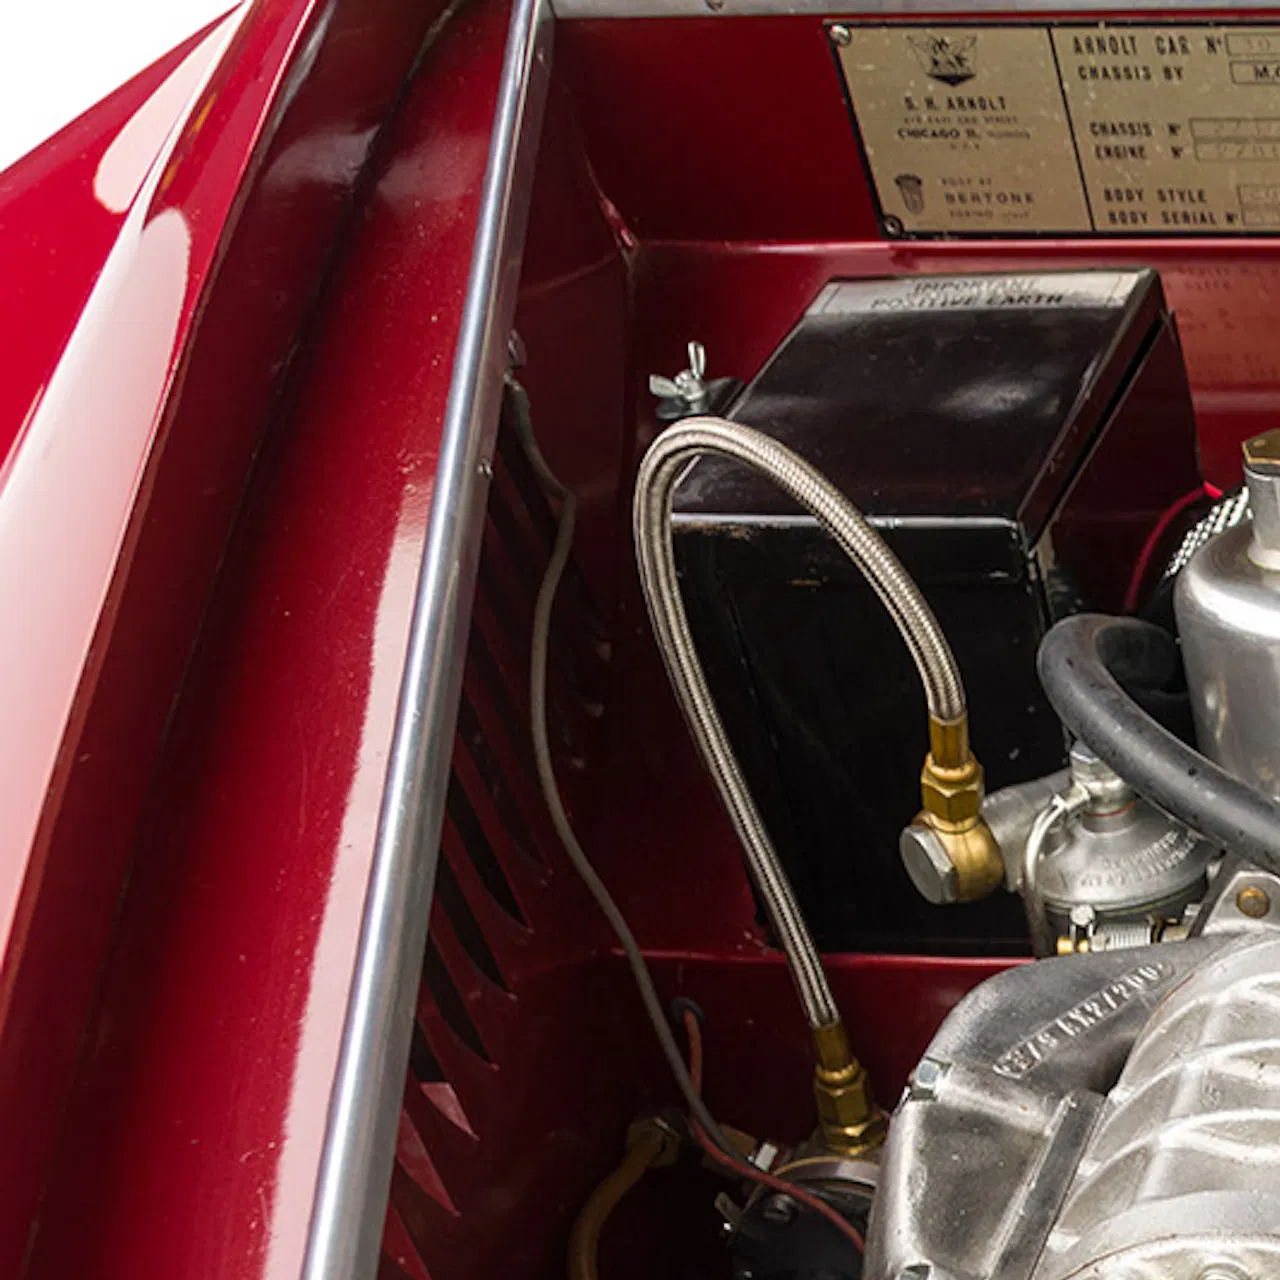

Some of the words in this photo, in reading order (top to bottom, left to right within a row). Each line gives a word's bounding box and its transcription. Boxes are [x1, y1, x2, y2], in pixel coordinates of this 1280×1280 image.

[1073, 36, 1138, 55] ARNOLT
[1156, 36, 1190, 55] CAR
[1078, 66, 1151, 81] CHASSIS
[1164, 66, 1184, 80] BY
[946, 96, 1007, 111] ARNOLT
[897, 127, 960, 140] CHICAGO
[1089, 122, 1153, 137] CHASSIS
[1095, 146, 1148, 160] ENGINE
[945, 191, 1035, 205] BERTONE
[1104, 188, 1144, 202] BODY
[1156, 189, 1208, 204] STYLE
[1109, 211, 1148, 225] BODY
[1161, 211, 1217, 225] SERIAL
[870, 294, 975, 309] POSITIVE
[985, 294, 1065, 308] EARTH
